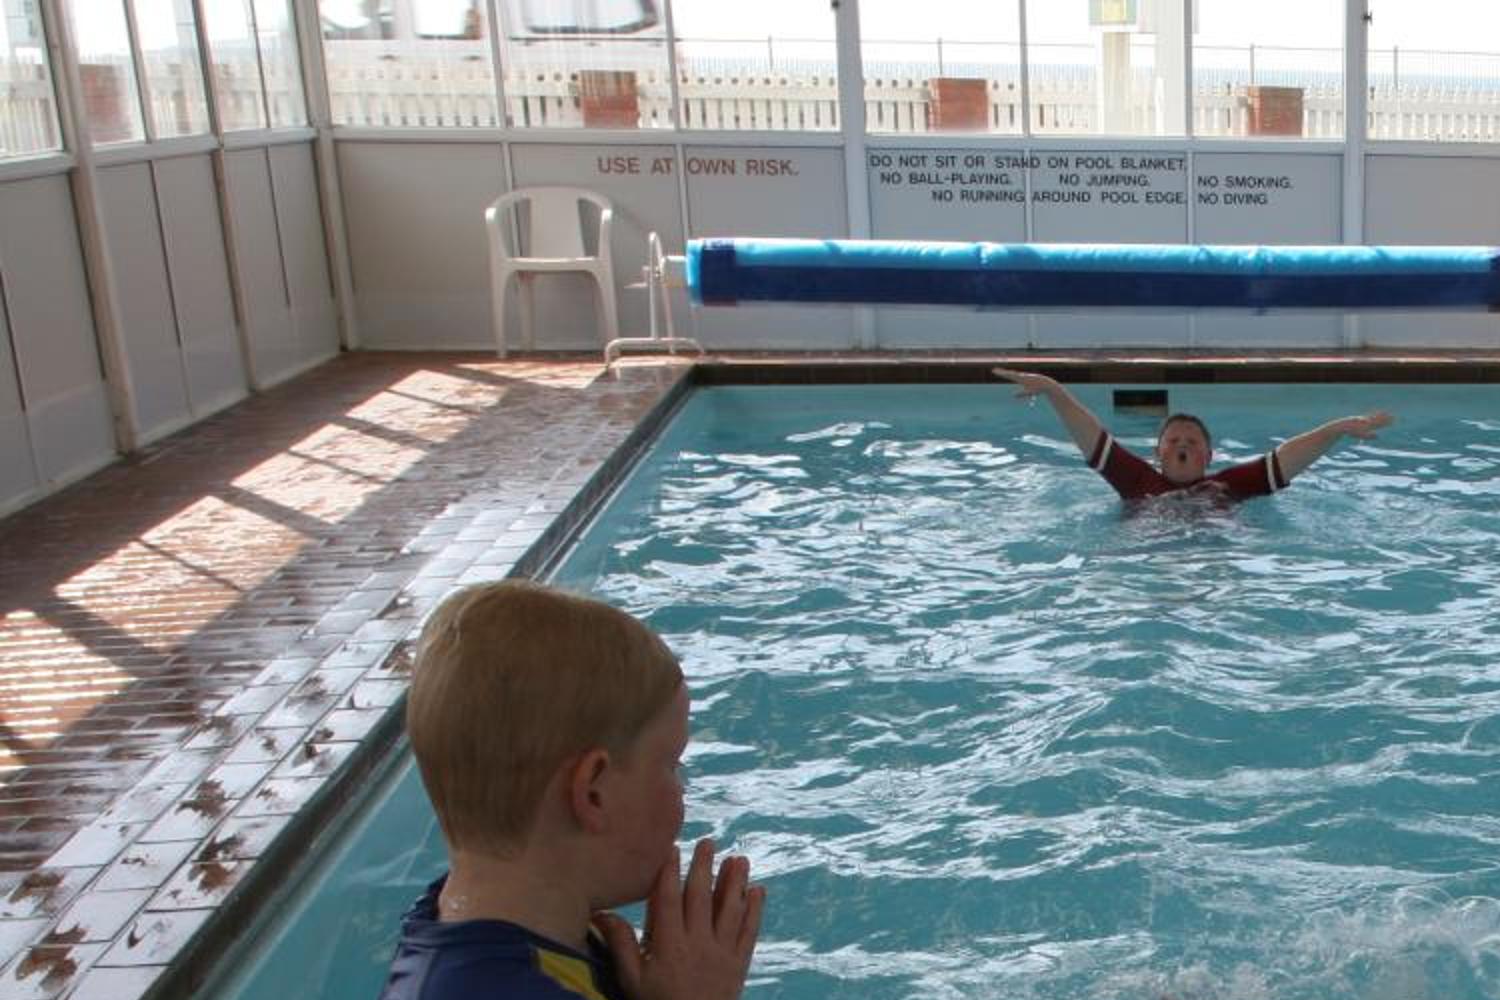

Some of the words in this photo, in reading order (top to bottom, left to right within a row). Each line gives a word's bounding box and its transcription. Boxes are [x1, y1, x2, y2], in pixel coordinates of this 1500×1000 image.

[597, 157, 640, 174] USE
[651, 158, 673, 175] AT
[687, 158, 735, 175] OWN
[747, 159, 799, 175] RISK.
[870, 155, 892, 167] DO
[900, 156, 927, 168] NOT
[935, 156, 956, 168] SIT
[964, 156, 985, 168] OR
[995, 157, 1040, 168] STAND
[1047, 157, 1069, 169] ON
[1076, 157, 1113, 169] POOL
[880, 173, 902, 184] NO
[1059, 174, 1080, 186] NO
[1198, 176, 1219, 187] NO
[932, 190, 953, 201] NO
[961, 190, 1025, 203] RUNNING
[1032, 191, 1091, 203] AROUND
[1102, 191, 1139, 204] POOL
[1198, 193, 1219, 205] NO
